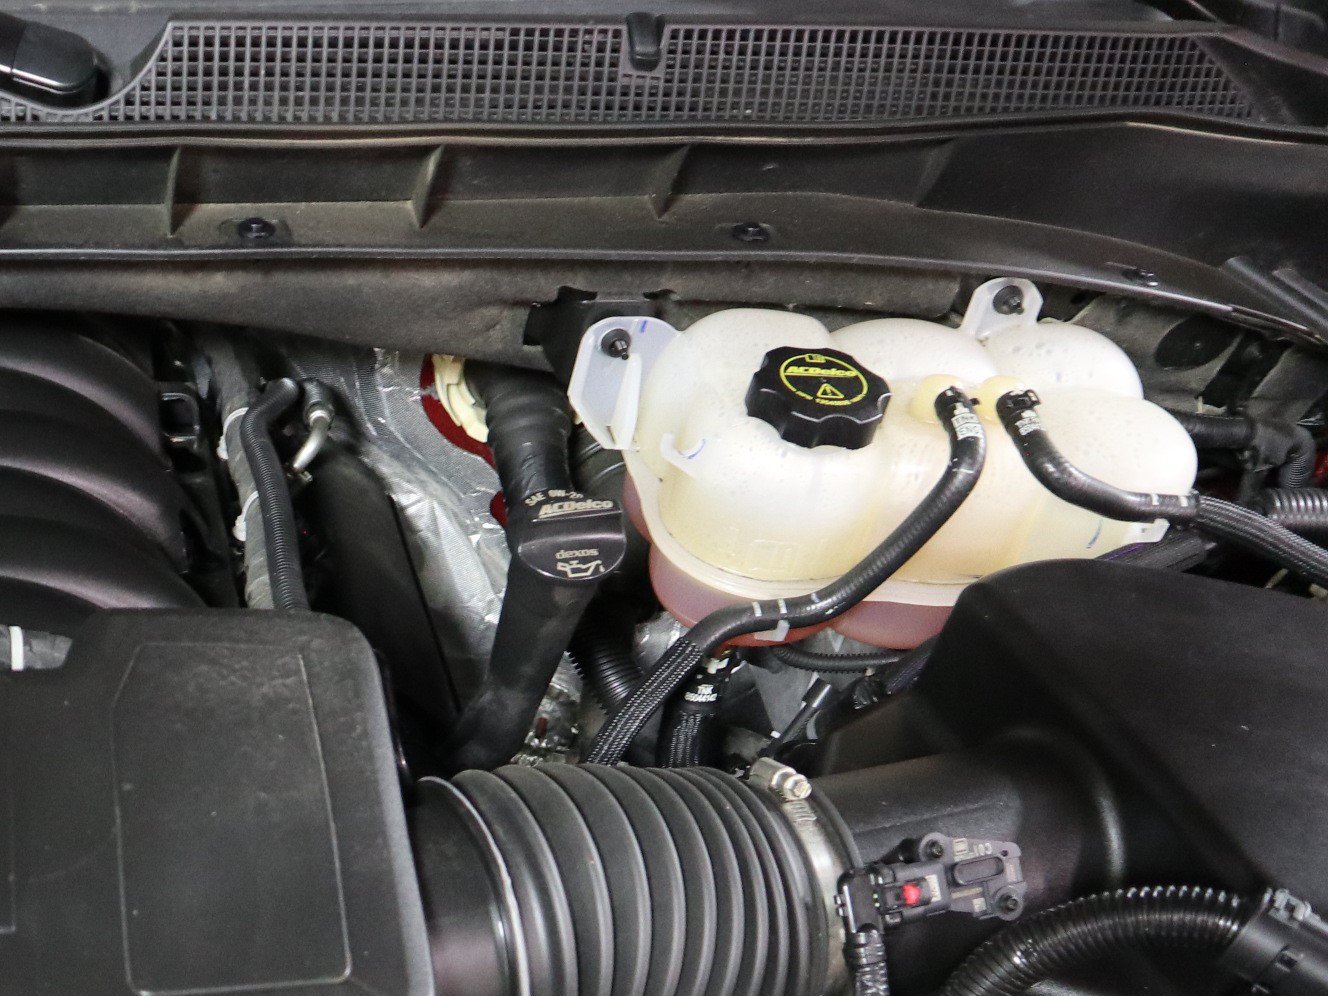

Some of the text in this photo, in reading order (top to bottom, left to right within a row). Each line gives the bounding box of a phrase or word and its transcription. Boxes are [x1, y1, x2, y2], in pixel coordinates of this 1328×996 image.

[524, 492, 547, 507] SAE
[538, 499, 614, 517] ACDelco
[555, 548, 599, 560] dexos
